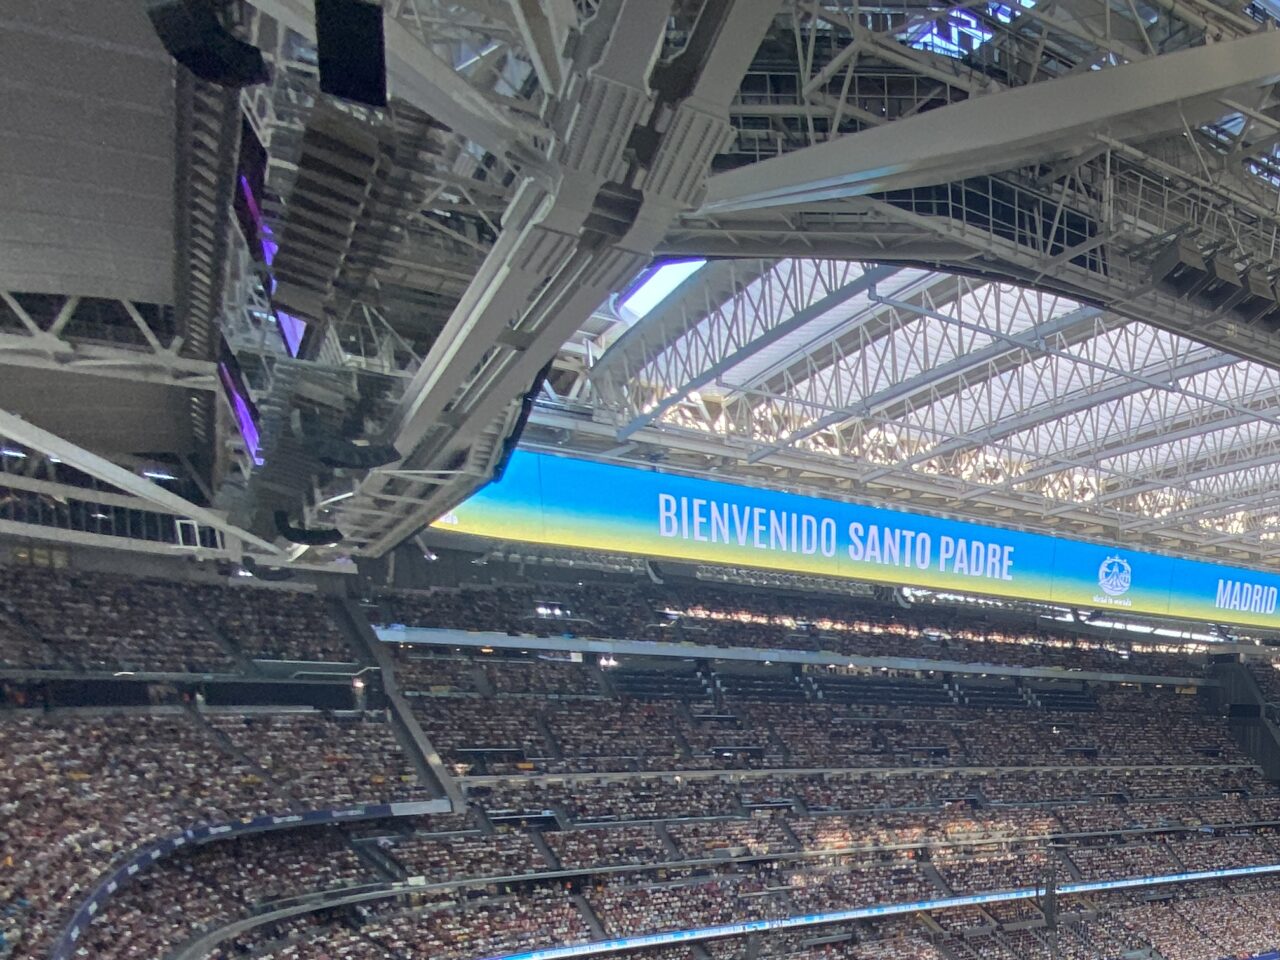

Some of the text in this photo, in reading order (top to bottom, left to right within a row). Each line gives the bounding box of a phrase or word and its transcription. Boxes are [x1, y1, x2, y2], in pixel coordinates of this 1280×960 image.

[658, 493, 1015, 581] BIENVENIDO SANTO PADRE
[1216, 579, 1277, 614] MADRID
